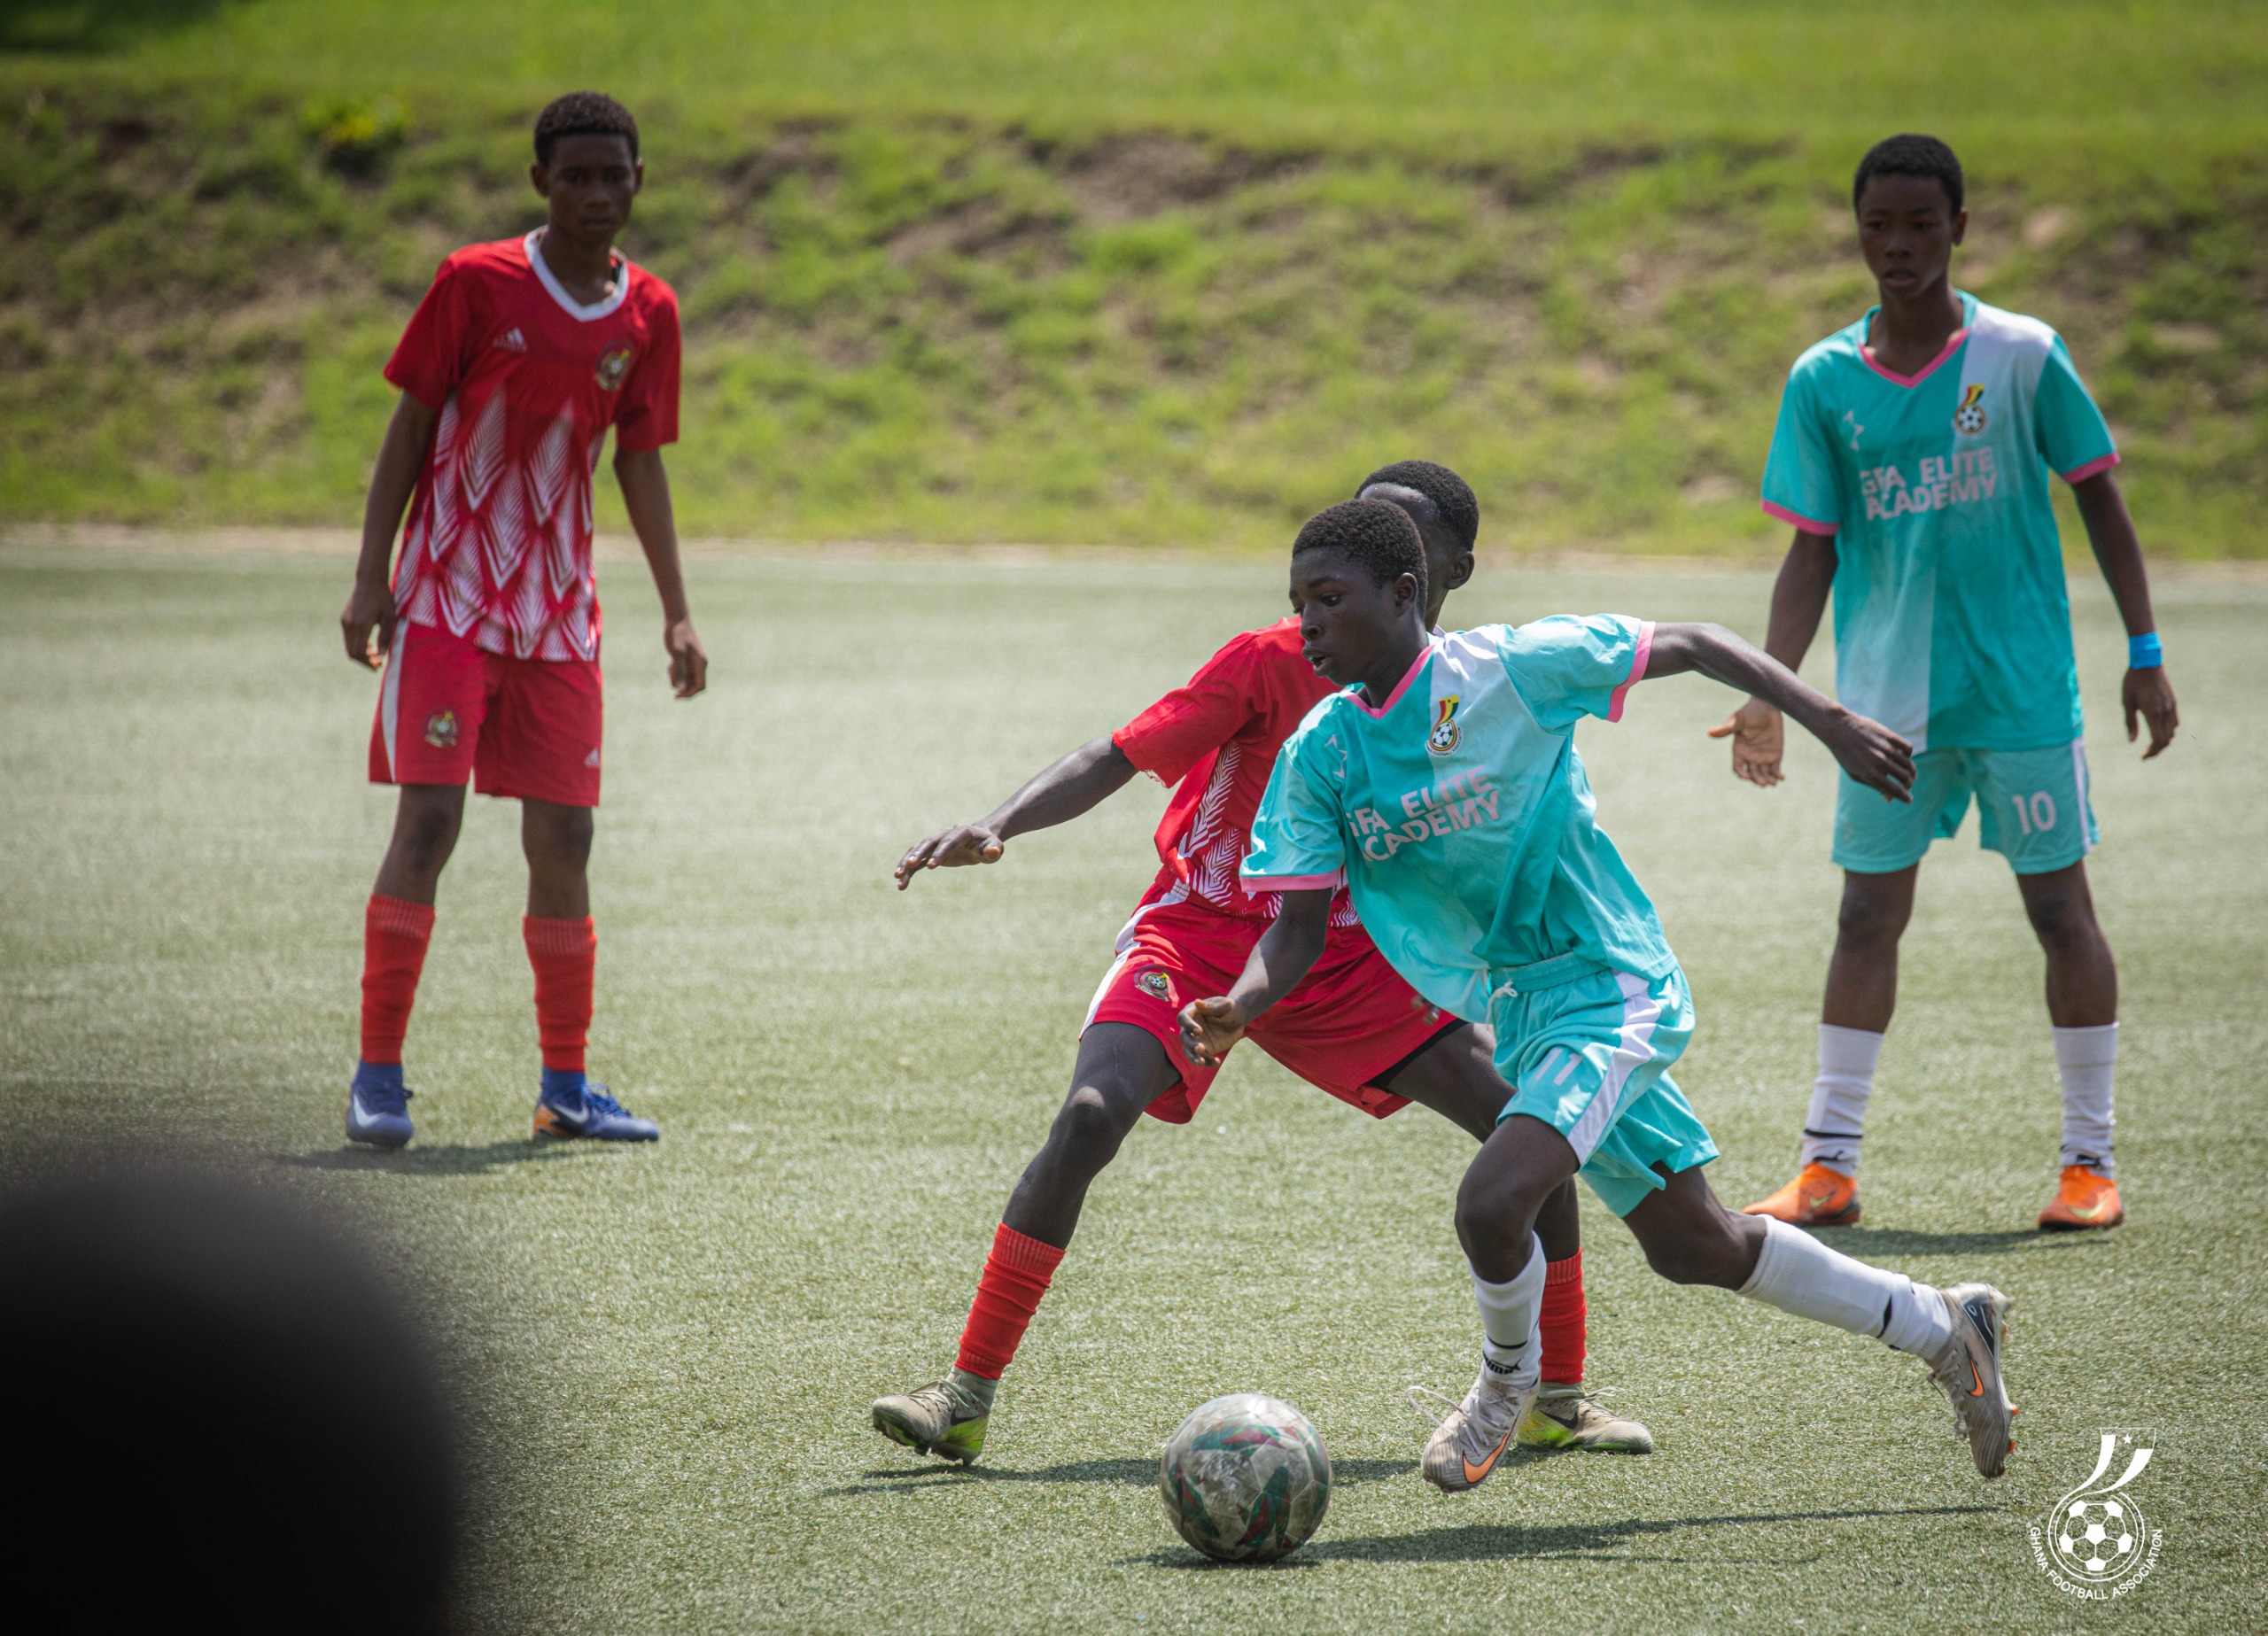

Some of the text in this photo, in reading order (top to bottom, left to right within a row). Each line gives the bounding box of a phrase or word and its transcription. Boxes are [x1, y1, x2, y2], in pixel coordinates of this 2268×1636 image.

[1919, 446, 1994, 485] ELITE
[1865, 471, 1997, 522] ACADEMY
[1400, 765, 1494, 818] ELITE
[2012, 790, 2057, 835] 10
